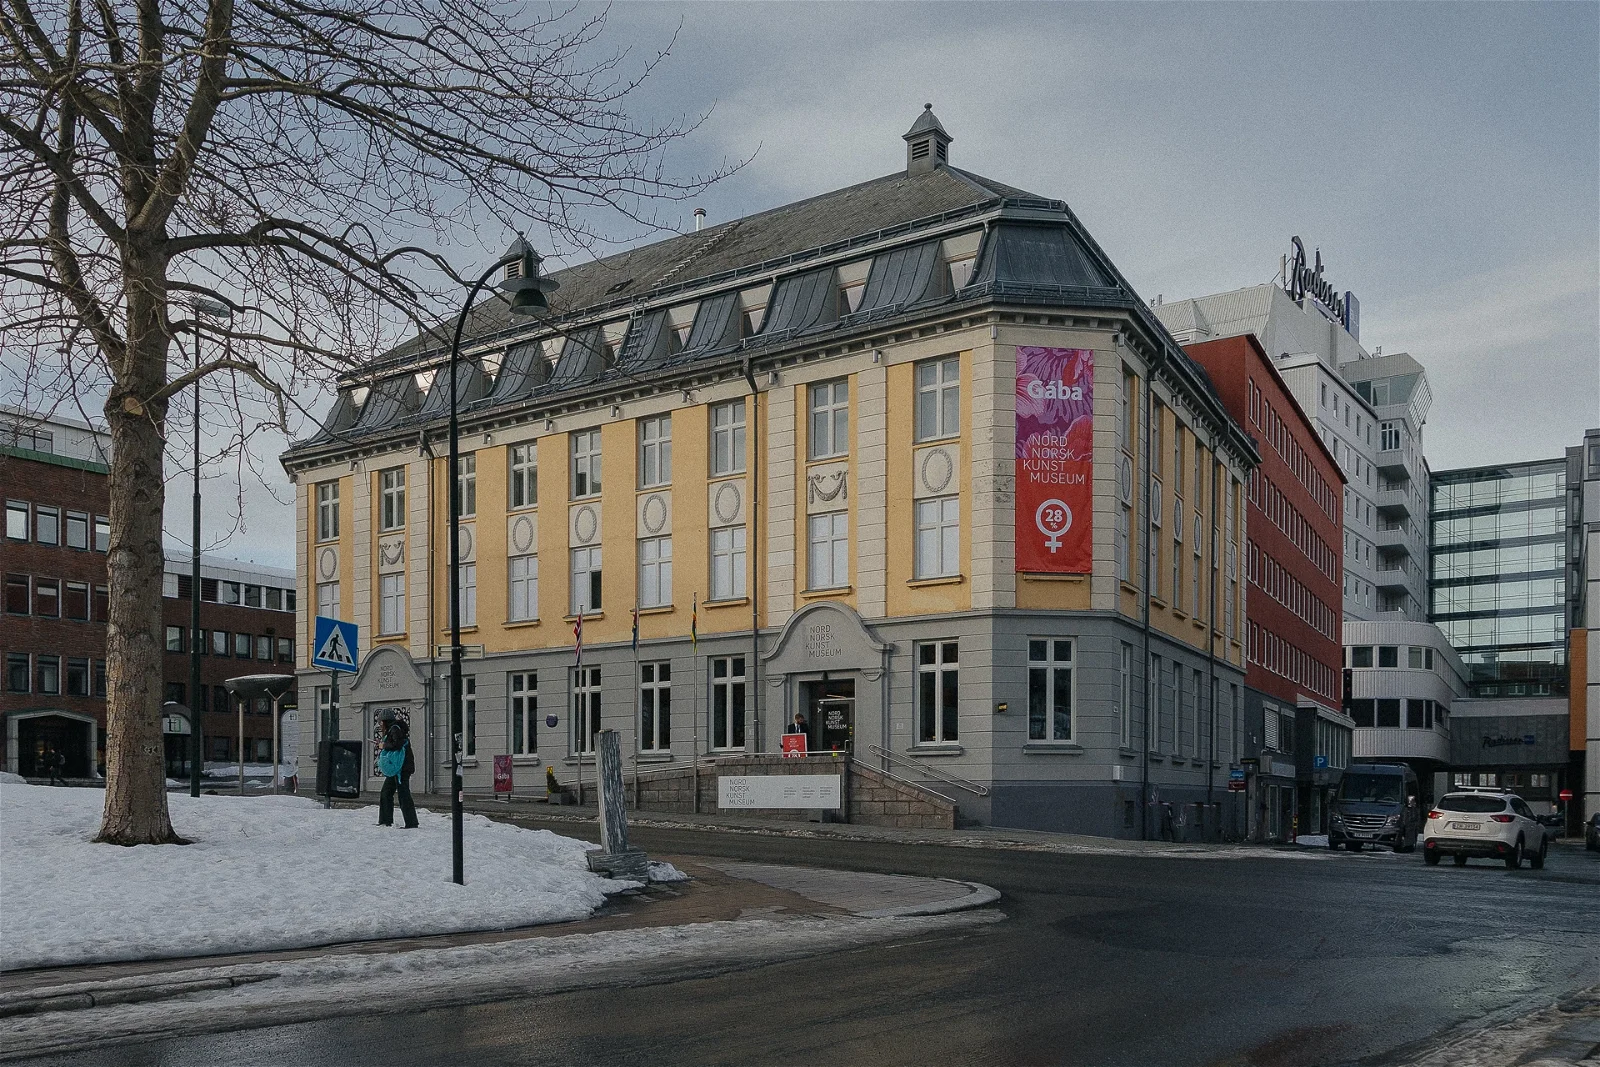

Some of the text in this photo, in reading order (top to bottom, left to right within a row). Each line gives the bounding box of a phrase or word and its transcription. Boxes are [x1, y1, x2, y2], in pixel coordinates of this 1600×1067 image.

[1027, 380, 1083, 401] Gába
[1031, 435, 1068, 447] NORD
[1031, 447, 1075, 459] NORSK
[1023, 459, 1066, 471] KUNST
[1030, 472, 1085, 485] MUSEUM
[1045, 509, 1063, 523] 28
[809, 625, 831, 634] NORD
[809, 633, 835, 642] NORSK
[805, 641, 830, 650] KUNST
[808, 649, 842, 658] MUSEUM
[1316, 757, 1325, 767] P
